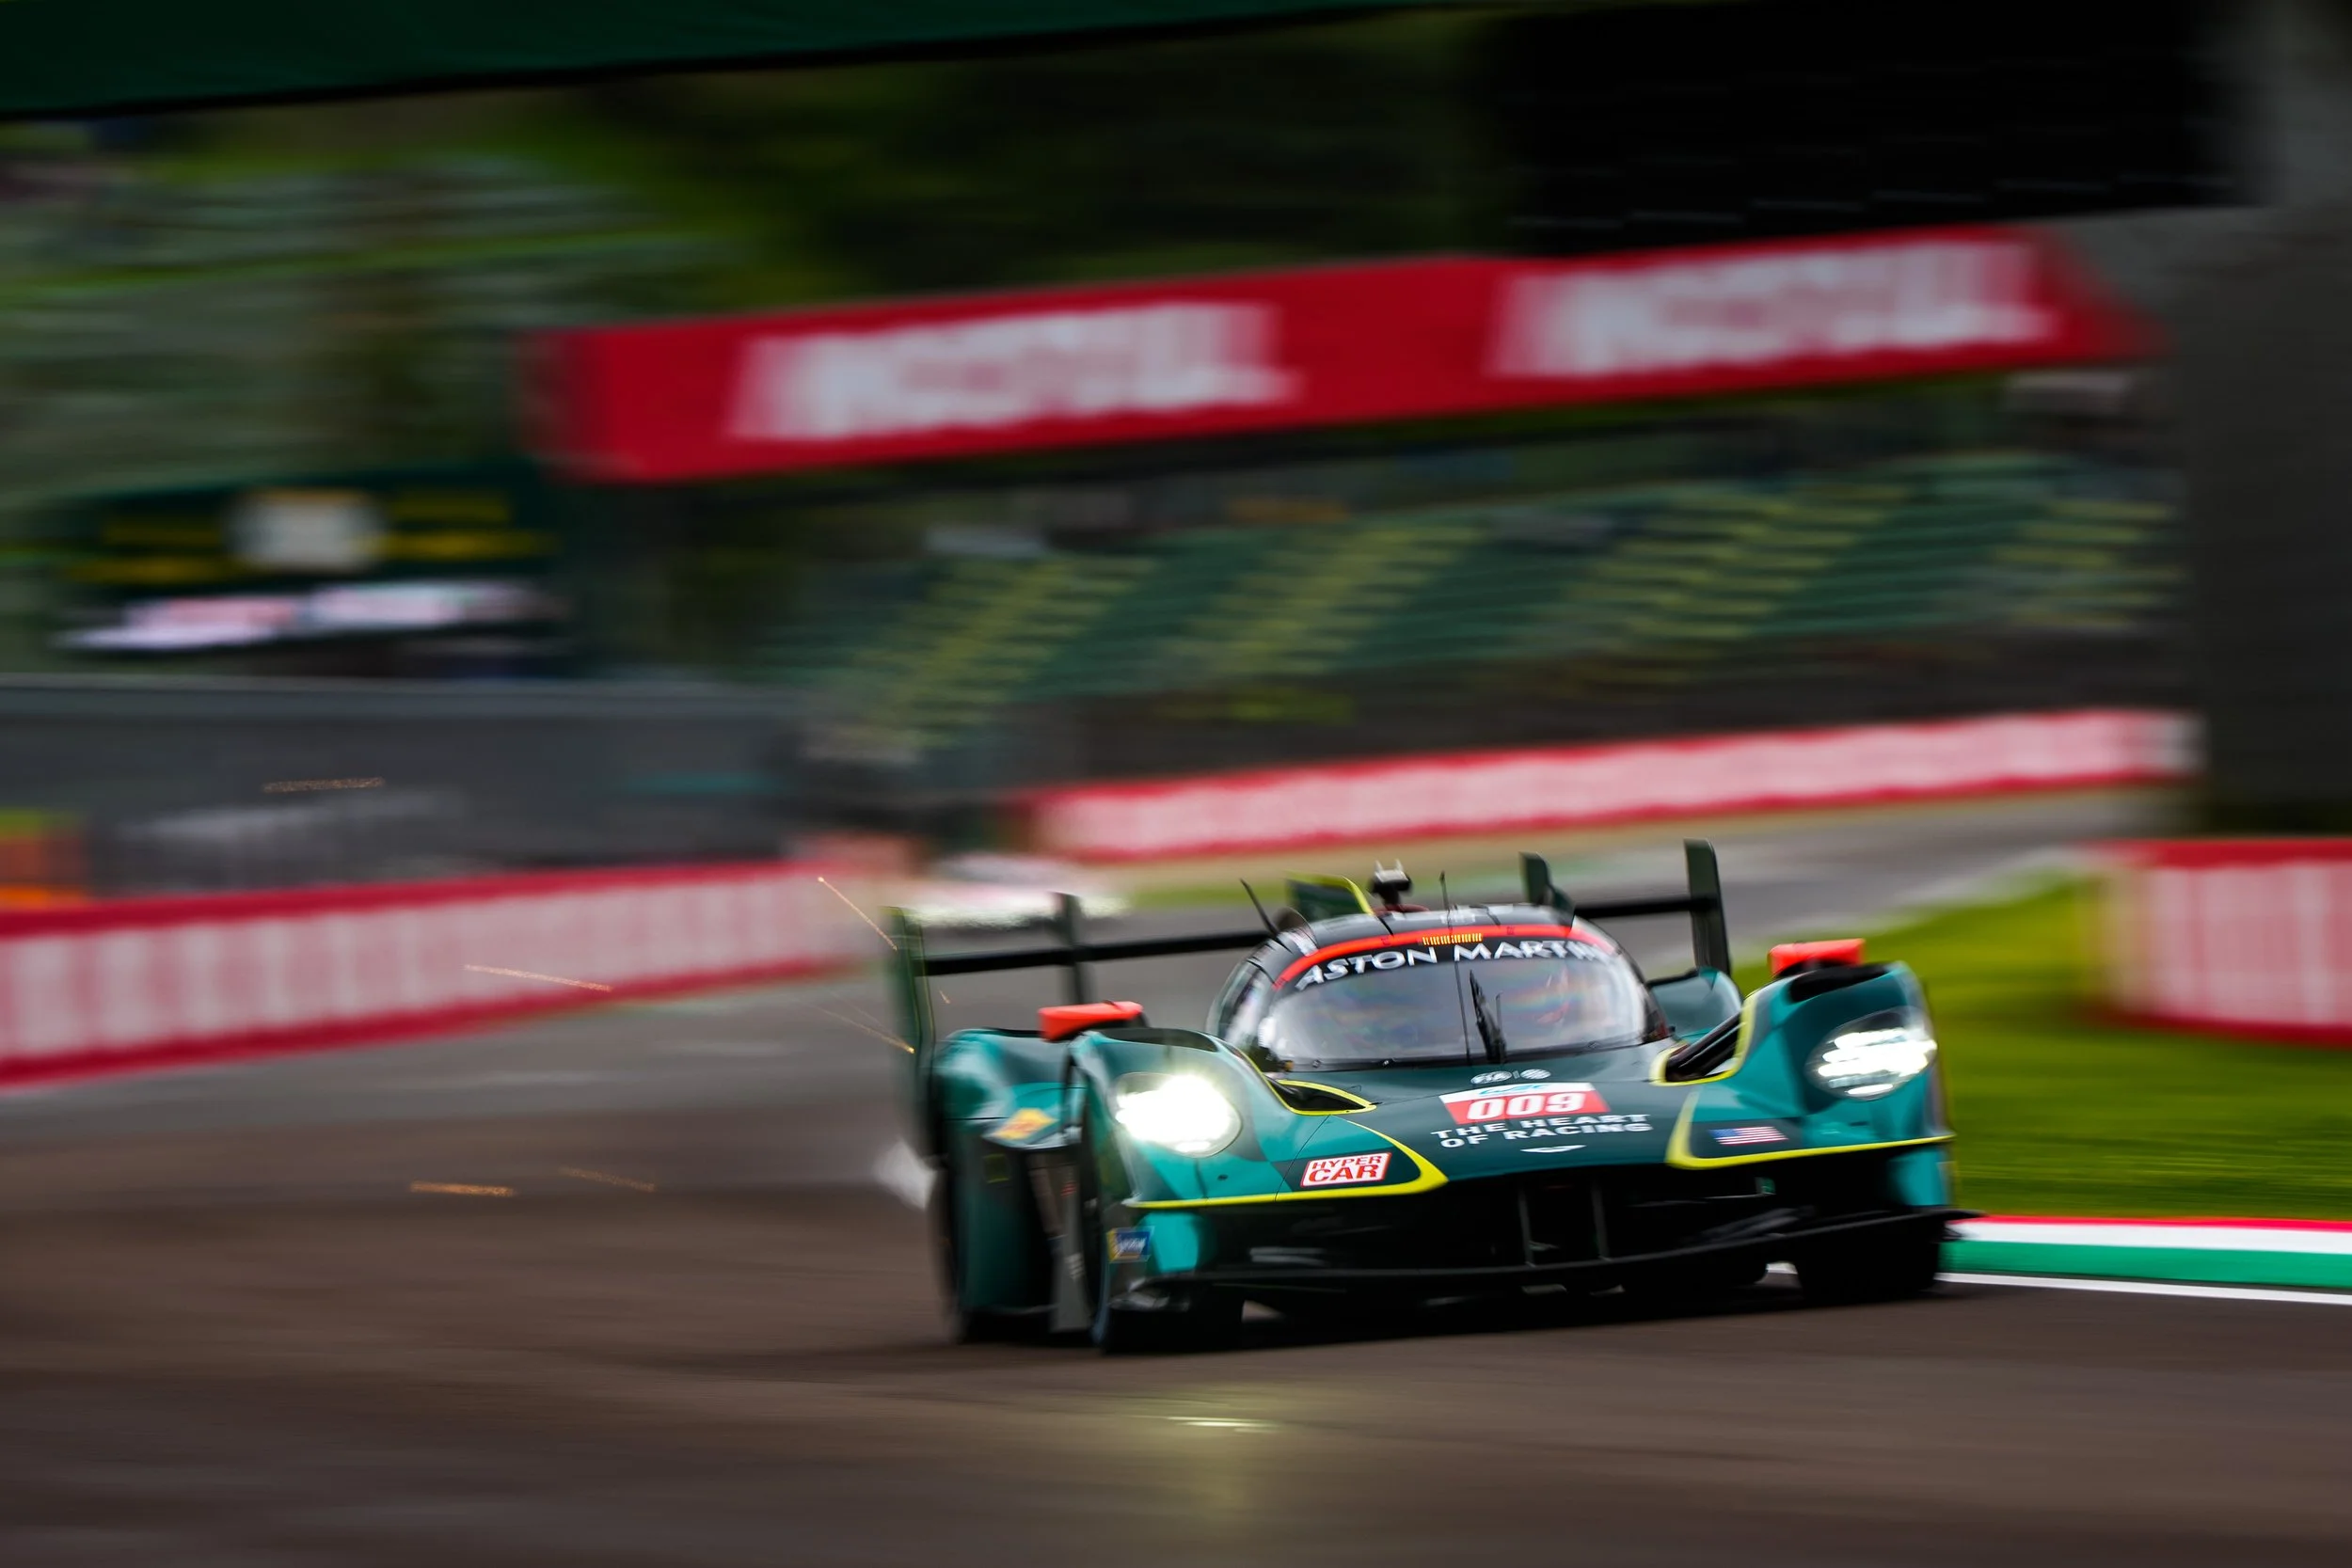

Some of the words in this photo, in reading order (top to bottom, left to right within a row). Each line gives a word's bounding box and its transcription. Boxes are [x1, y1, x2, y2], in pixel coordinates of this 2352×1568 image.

[1295, 946, 1438, 990] ASTON
[1467, 1092, 1586, 1120] 009
[1431, 1123, 1507, 1139] THE
[1520, 1114, 1650, 1129] HEART
[1440, 1134, 1488, 1148] OF
[1504, 1123, 1653, 1140] RACING
[1309, 1164, 1379, 1182] CAR
[1311, 1155, 1382, 1169] HYPER
